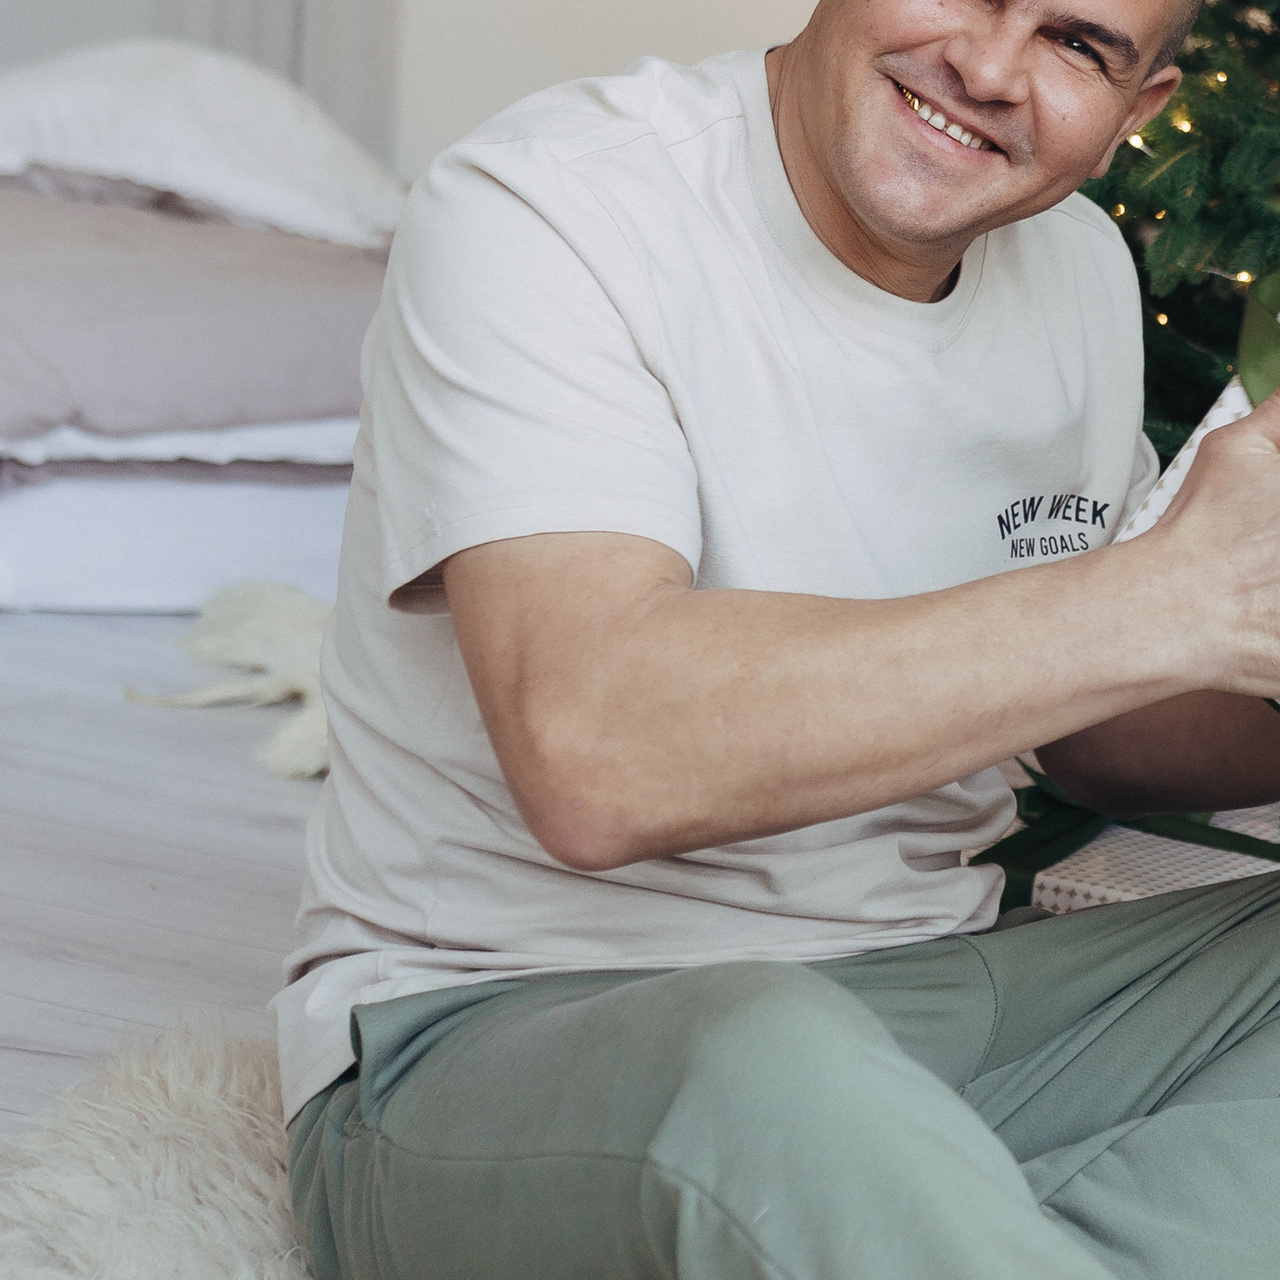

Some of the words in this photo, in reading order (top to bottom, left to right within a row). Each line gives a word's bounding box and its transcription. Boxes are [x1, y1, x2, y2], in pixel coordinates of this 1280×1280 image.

[997, 495, 1044, 540] NEW
[1047, 494, 1110, 529] WEEK
[1010, 537, 1035, 558] NEW
[1040, 532, 1089, 556] GOALS
